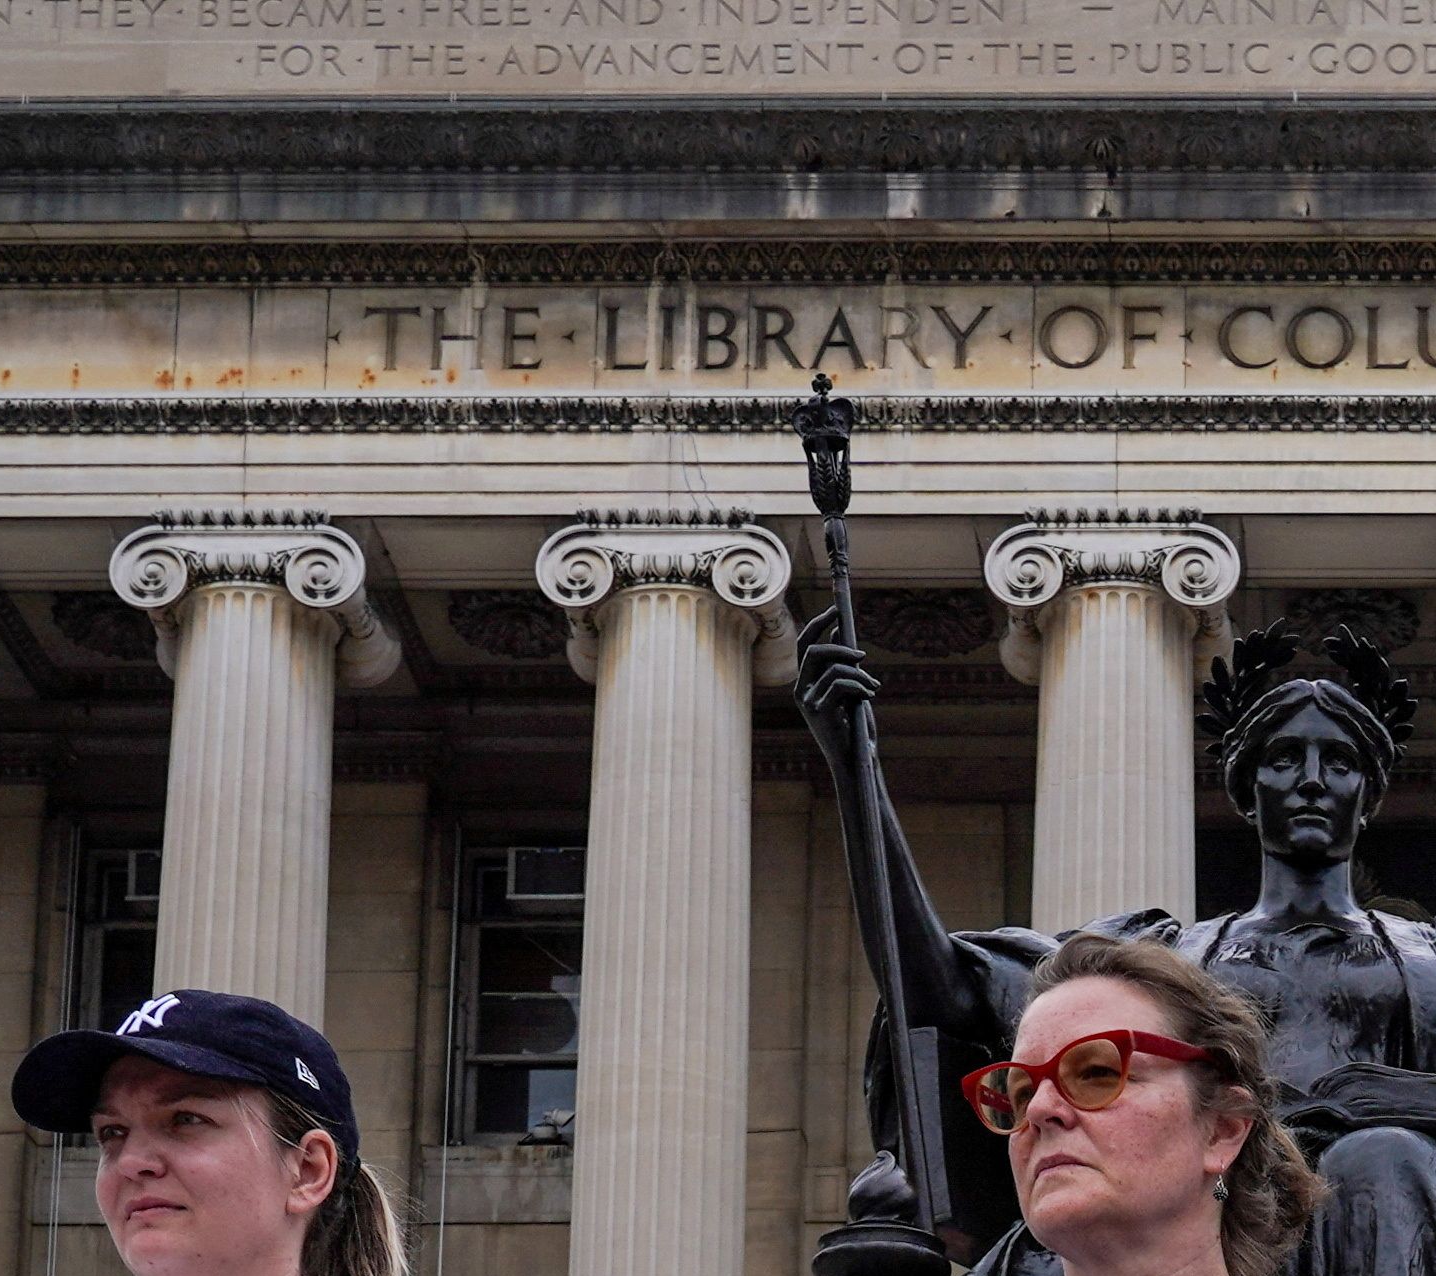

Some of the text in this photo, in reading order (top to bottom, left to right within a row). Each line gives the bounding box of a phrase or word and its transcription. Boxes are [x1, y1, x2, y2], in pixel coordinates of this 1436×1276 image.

[49, 0, 166, 28] THEY
[199, 0, 386, 28] BECAME
[418, 0, 532, 28] FREE
[563, 0, 664, 28] AND
[254, 44, 346, 78] FOR
[373, 44, 467, 78] THE
[496, 44, 866, 78] ADVANCEMENT
[892, 44, 954, 78] OF
[982, 44, 1075, 78] THE
[1114, 44, 1275, 78] PUBLIC
[365, 305, 545, 373] THE
[601, 305, 994, 373] LIBRARY
[1038, 305, 1164, 373] OF
